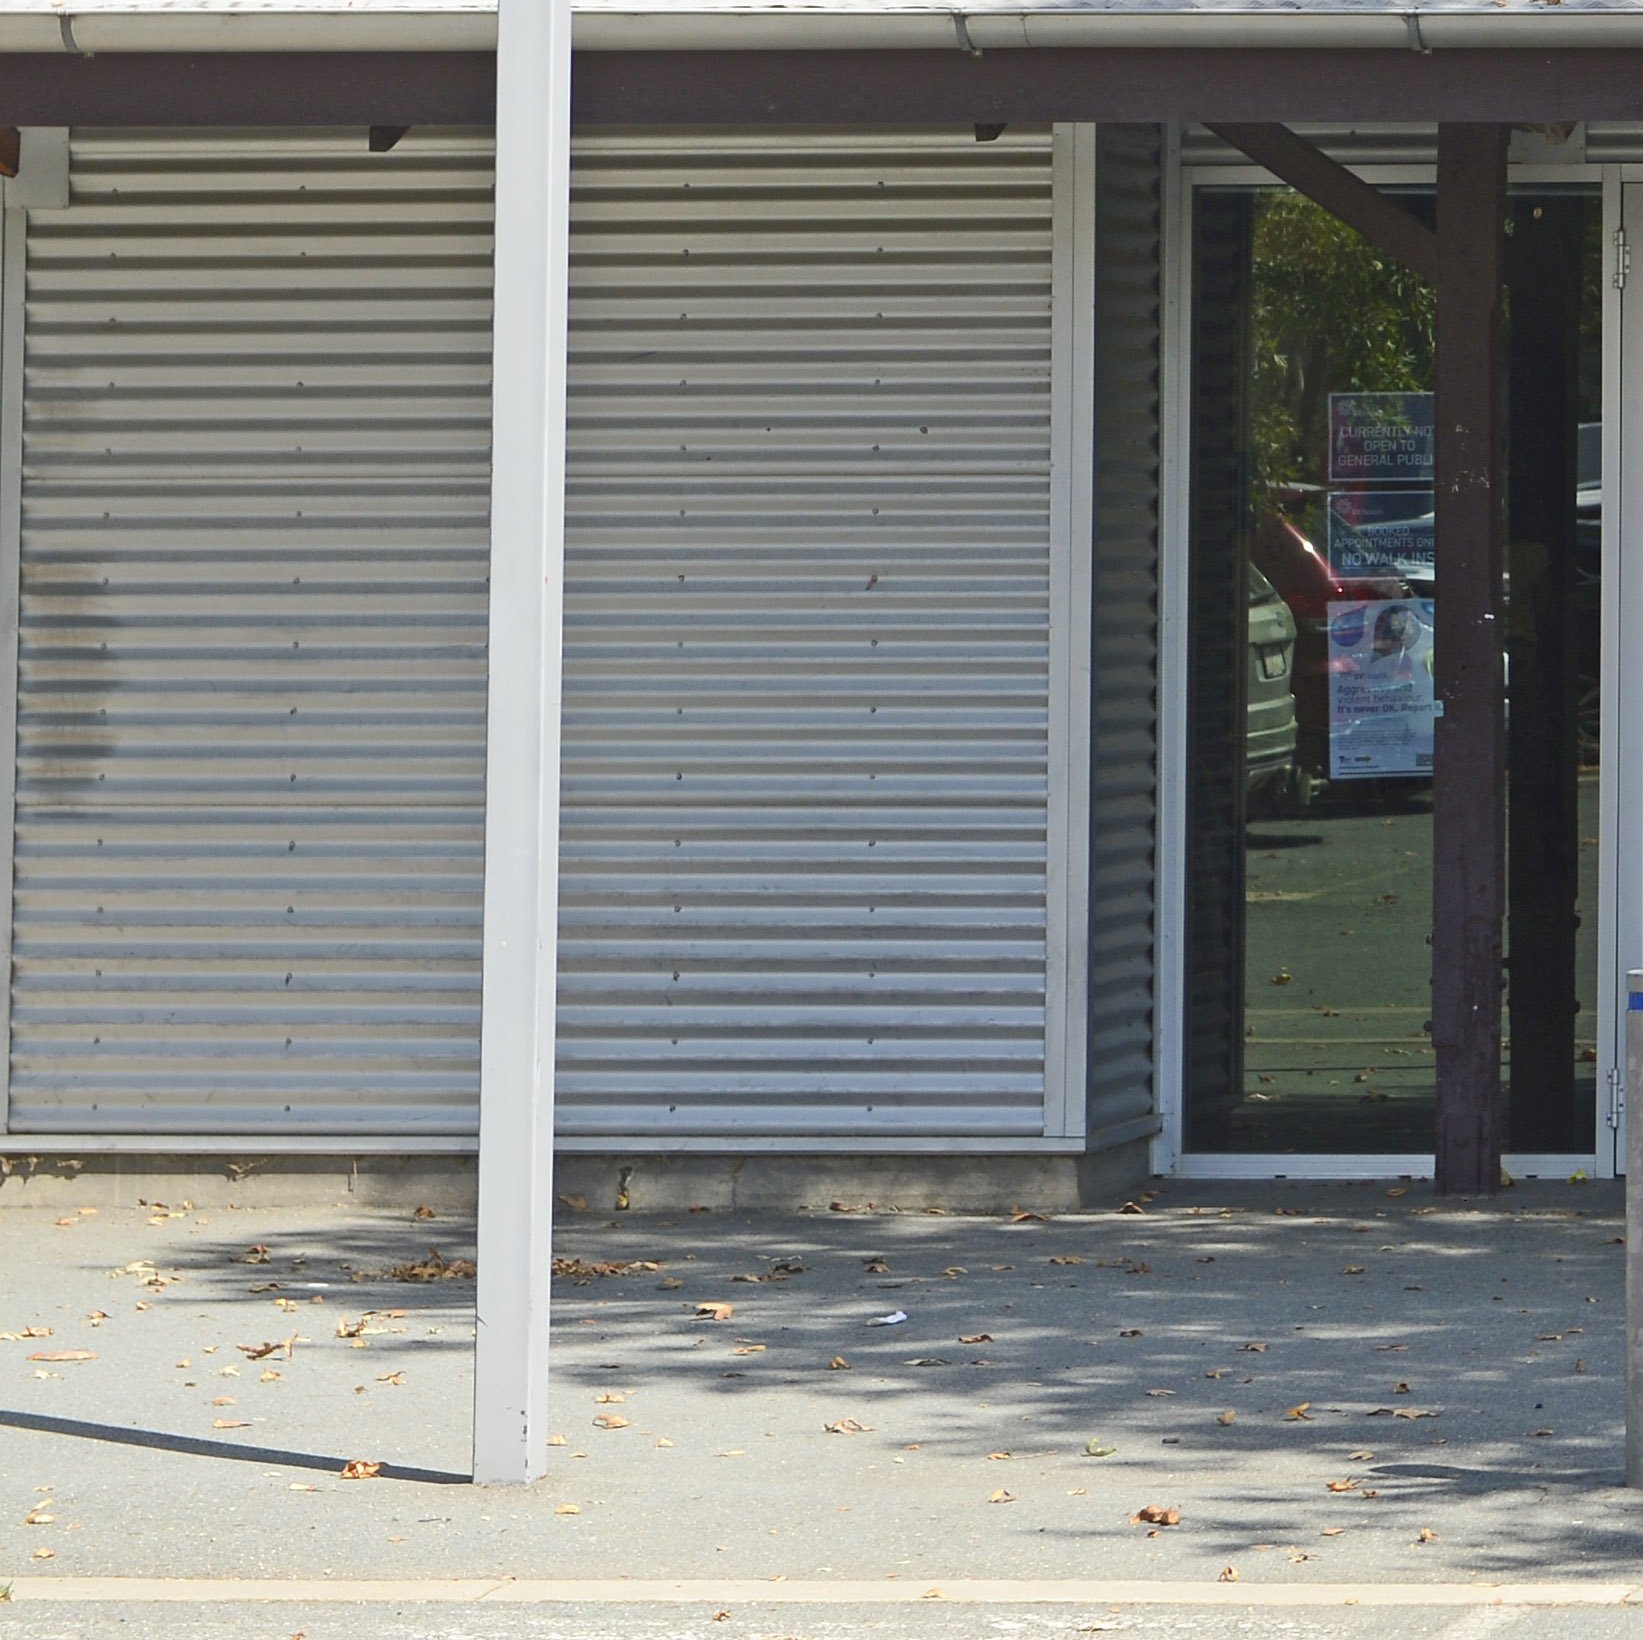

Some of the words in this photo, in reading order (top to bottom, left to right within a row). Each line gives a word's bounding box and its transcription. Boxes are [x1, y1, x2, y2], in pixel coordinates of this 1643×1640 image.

[1414, 425, 1435, 438] NO
[1364, 440, 1396, 452] OPEN
[1401, 440, 1416, 452] TO
[1338, 454, 1394, 467] GENERAL
[1397, 453, 1434, 466] PUBLI
[1367, 526, 1410, 536] BOOKED
[1334, 537, 1414, 548] APPOINTMENTS
[1342, 553, 1361, 566] NO
[1363, 552, 1407, 566] WALK
